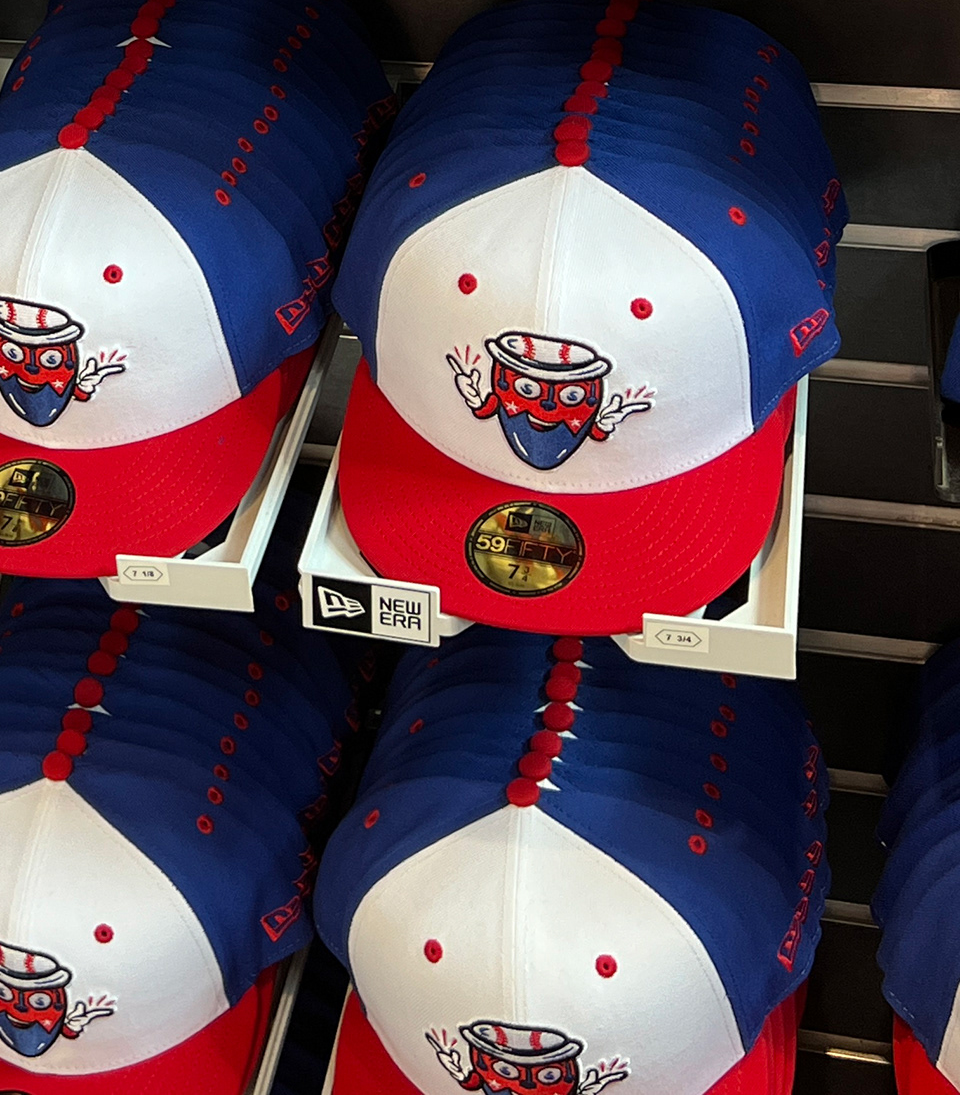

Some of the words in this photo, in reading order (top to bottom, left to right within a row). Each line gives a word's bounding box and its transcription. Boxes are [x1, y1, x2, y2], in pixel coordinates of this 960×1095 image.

[475, 534, 573, 564] 59FIFTY
[380, 596, 421, 615] NEW
[380, 611, 421, 630] ERA
